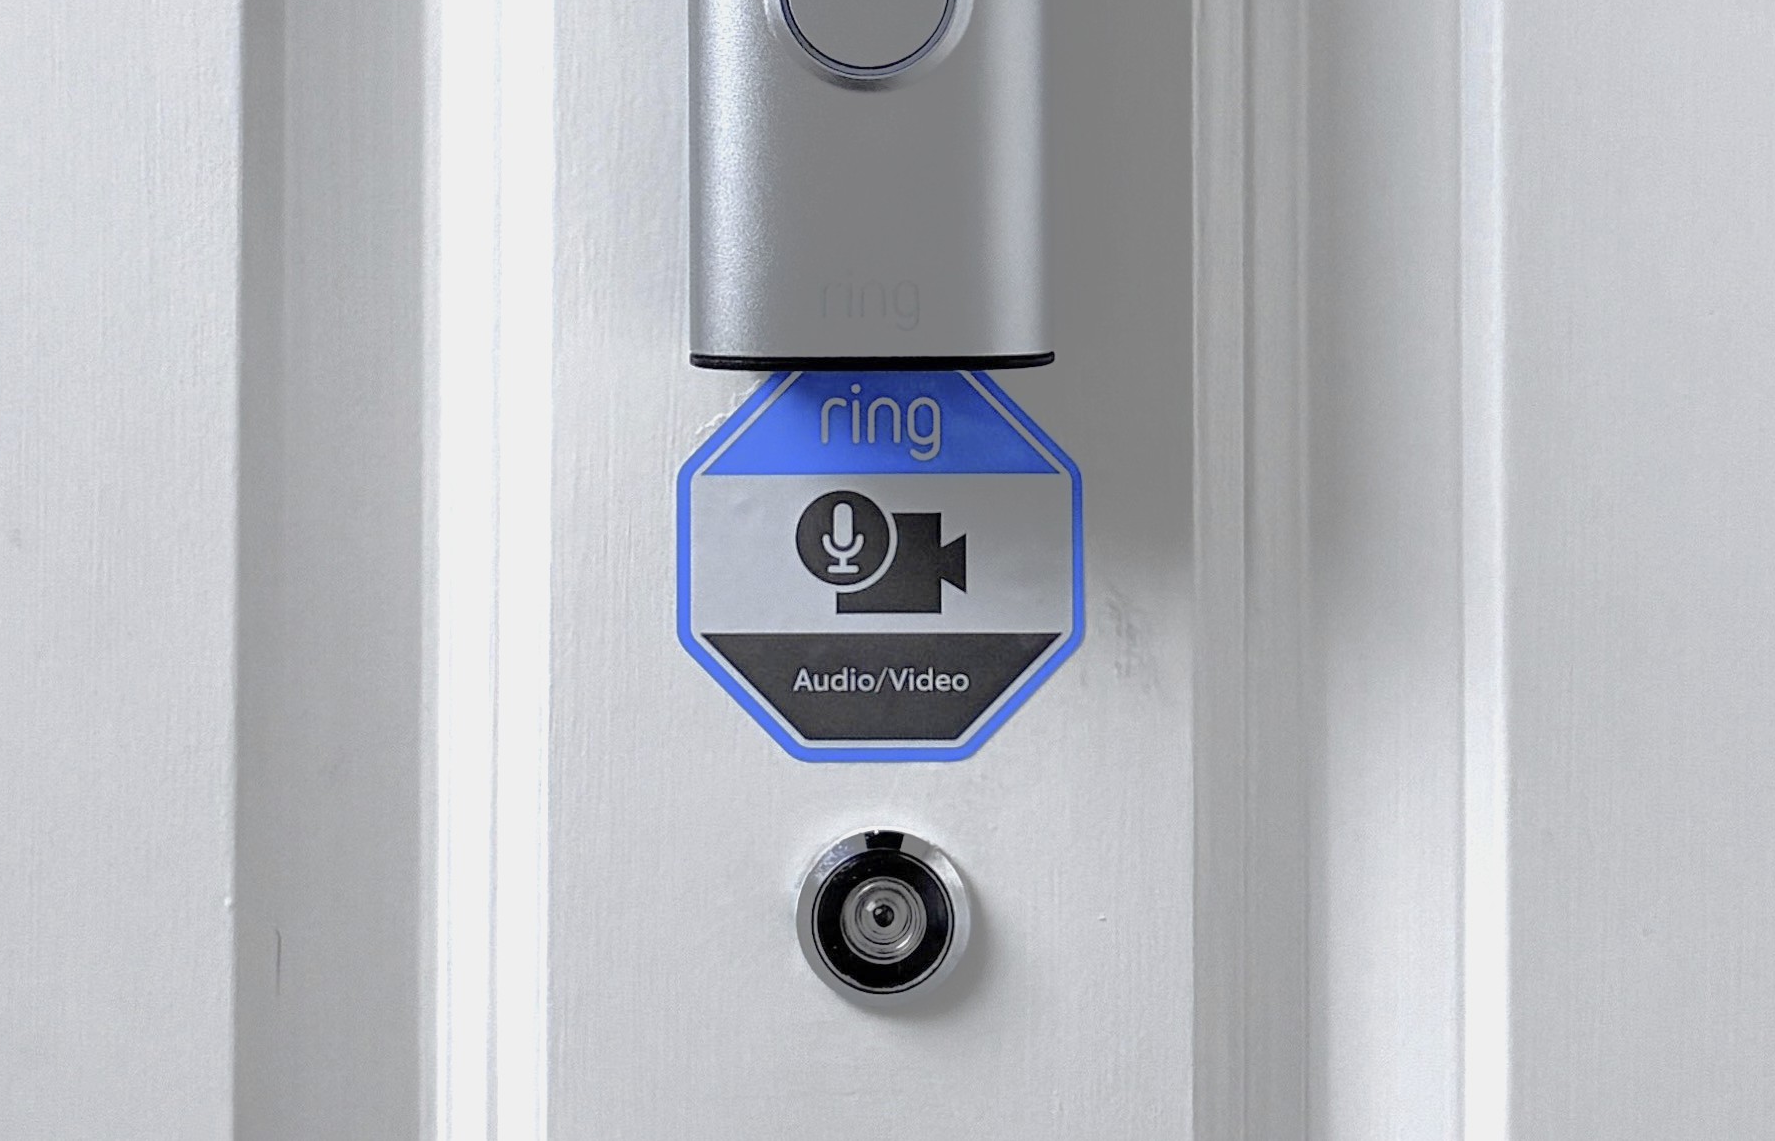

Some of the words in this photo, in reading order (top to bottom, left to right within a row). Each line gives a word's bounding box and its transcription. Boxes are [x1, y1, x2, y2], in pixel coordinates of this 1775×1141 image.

[820, 269, 921, 332] ring
[820, 384, 942, 462] ring
[792, 667, 970, 693] Audio/Video
